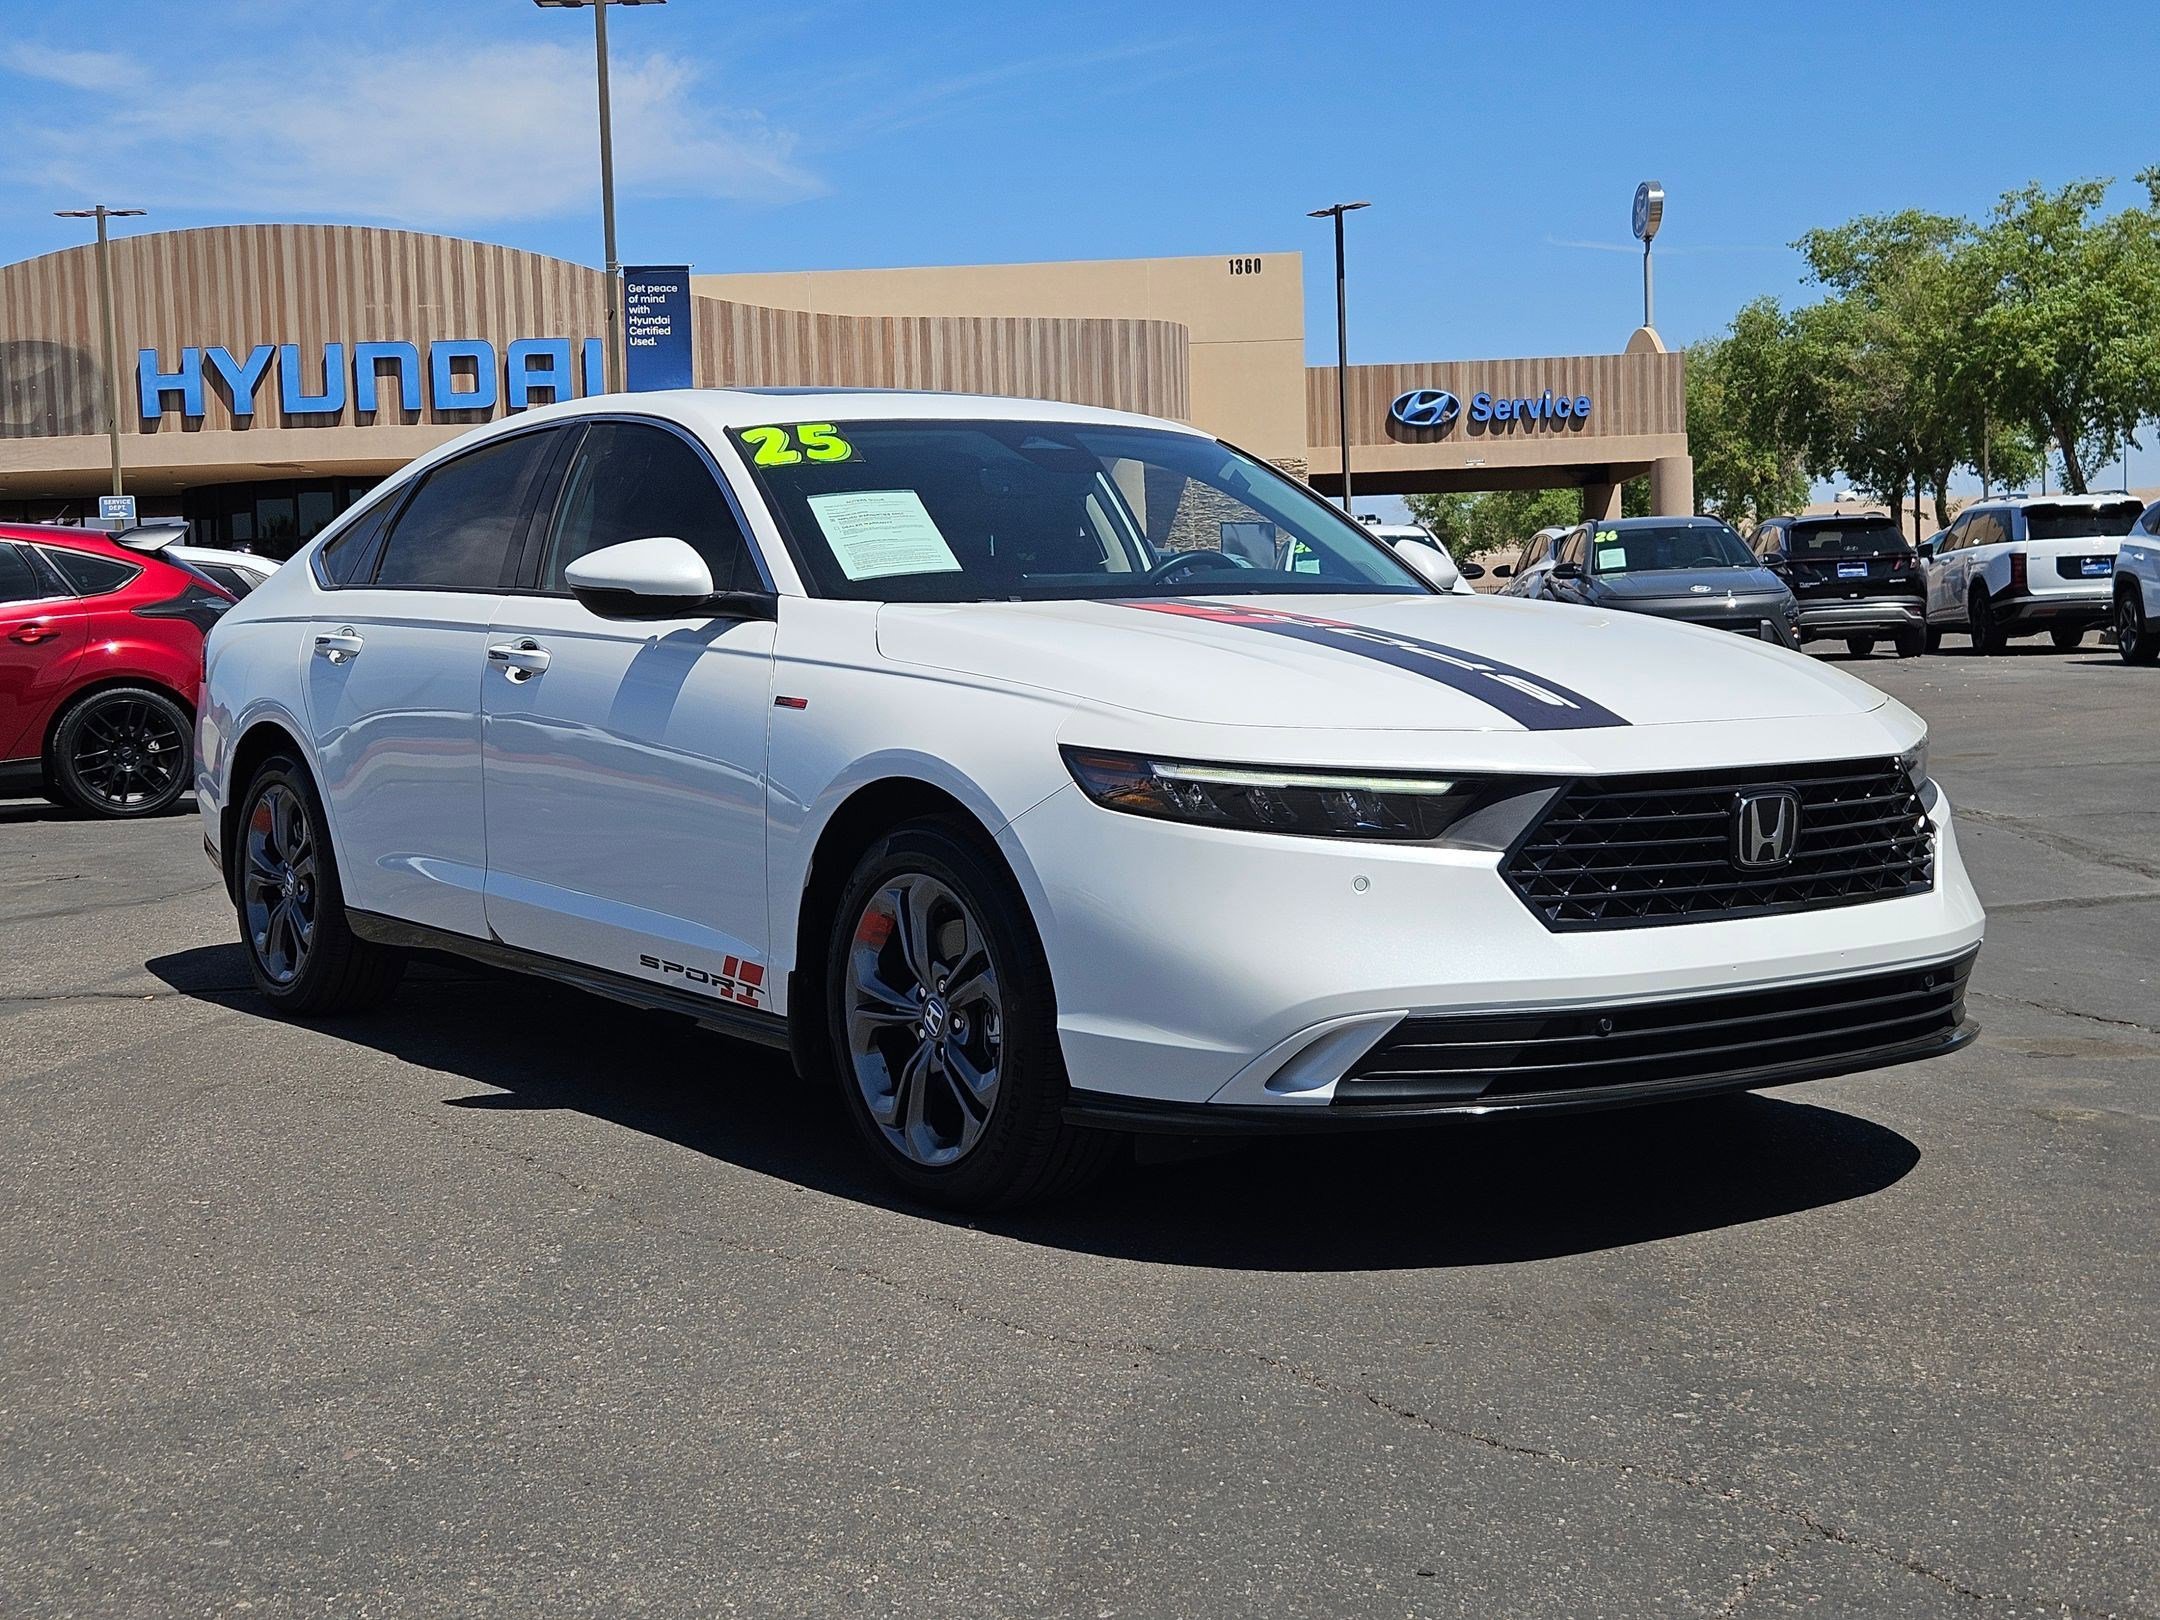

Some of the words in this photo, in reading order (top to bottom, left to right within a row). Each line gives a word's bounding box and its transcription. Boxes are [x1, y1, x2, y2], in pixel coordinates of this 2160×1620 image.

[1228, 258, 1261, 275] 1360
[628, 284, 646, 293] Get
[648, 286, 678, 294] peace
[628, 294, 639, 303] of
[640, 294, 665, 303] mind
[629, 305, 650, 314] with
[629, 316, 670, 325] Hyundai
[629, 326, 671, 335] Certified
[630, 337, 657, 346] Used.
[138, 338, 603, 418] HYUNDAI
[1471, 389, 1592, 422] Service
[740, 423, 852, 466] 25
[1594, 530, 1618, 543] 26
[640, 954, 766, 997] SPORT
